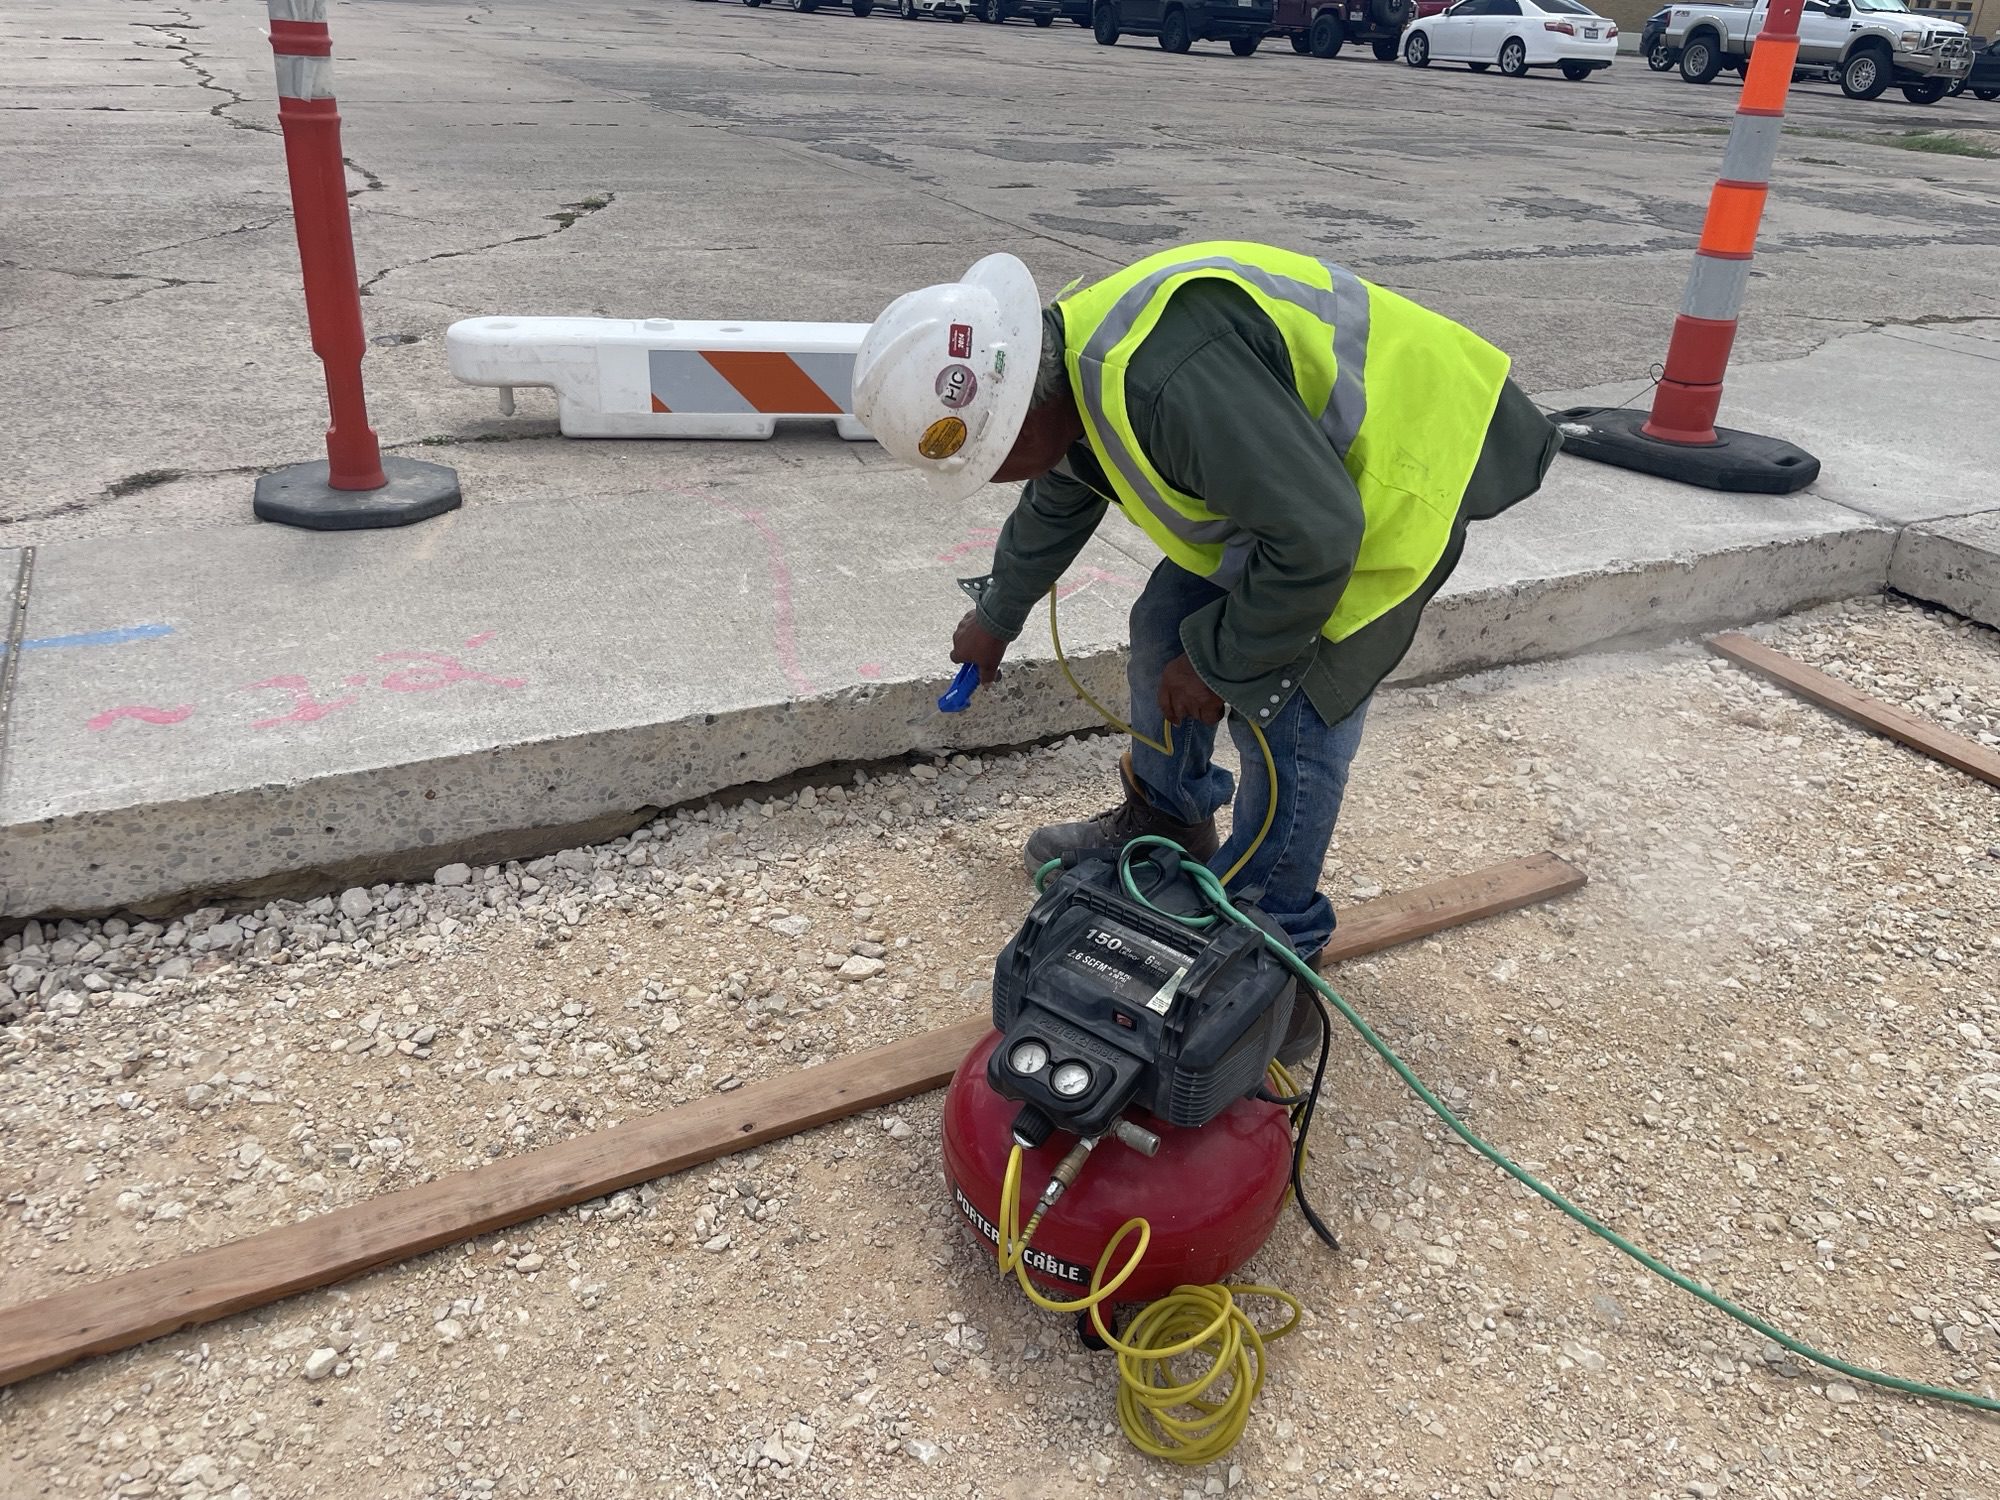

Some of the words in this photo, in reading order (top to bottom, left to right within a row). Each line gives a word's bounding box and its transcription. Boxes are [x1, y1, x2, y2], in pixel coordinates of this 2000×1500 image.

[1086, 928, 1122, 950] 150
[1067, 949, 1083, 960] 2.6
[1144, 955, 1156, 965] 6
[956, 1187, 1000, 1245] PORTER
[1023, 1250, 1080, 1281] CABLE
